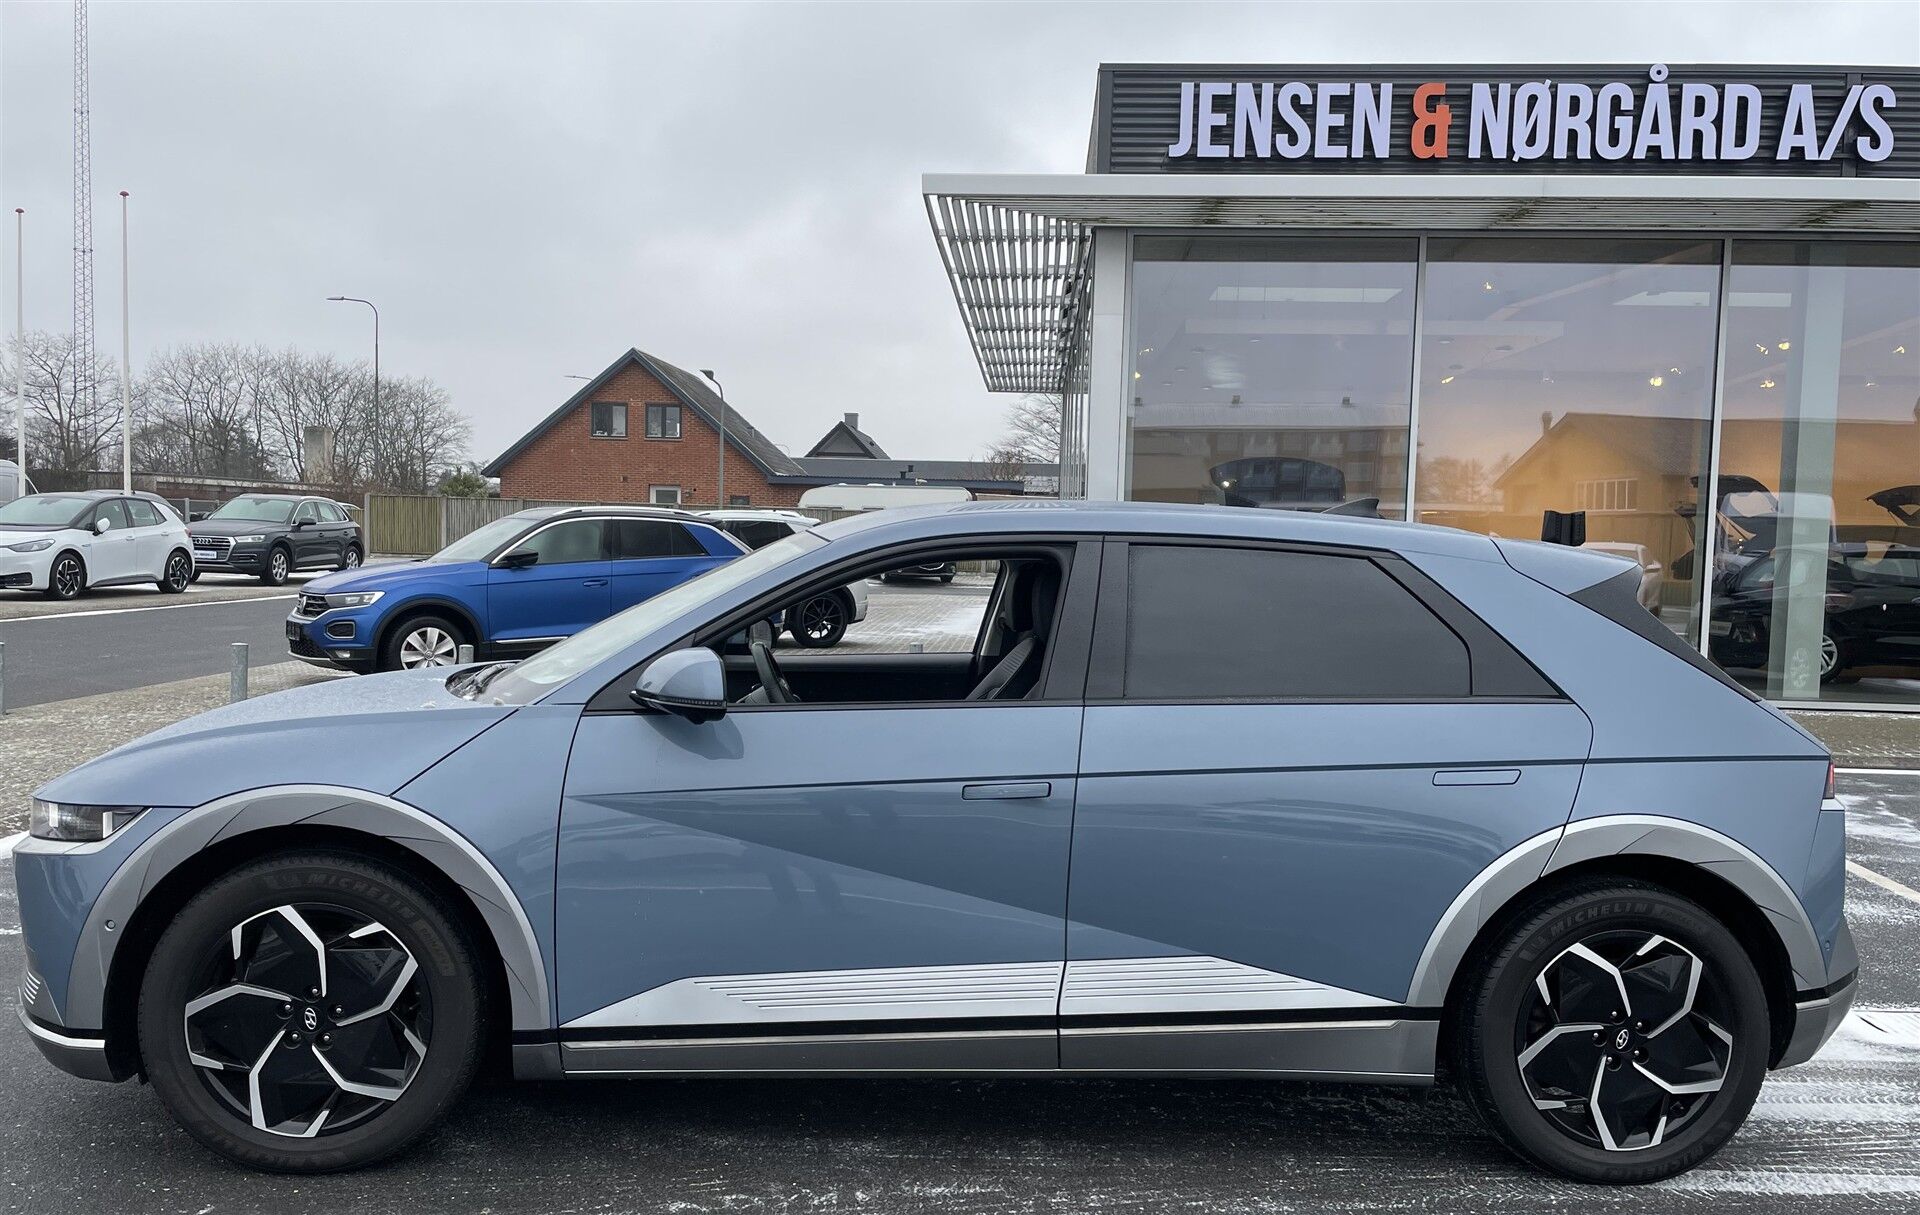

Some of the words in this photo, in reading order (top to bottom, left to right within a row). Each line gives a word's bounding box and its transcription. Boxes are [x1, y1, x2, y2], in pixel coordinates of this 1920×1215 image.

[1168, 81, 1393, 159] JENSEN
[1411, 83, 1452, 159] &
[1468, 63, 1762, 161] NØRGÅRD
[1776, 83, 1897, 162] A/S
[306, 872, 417, 920] MICHELIN
[1551, 902, 1649, 937] MICHELIN
